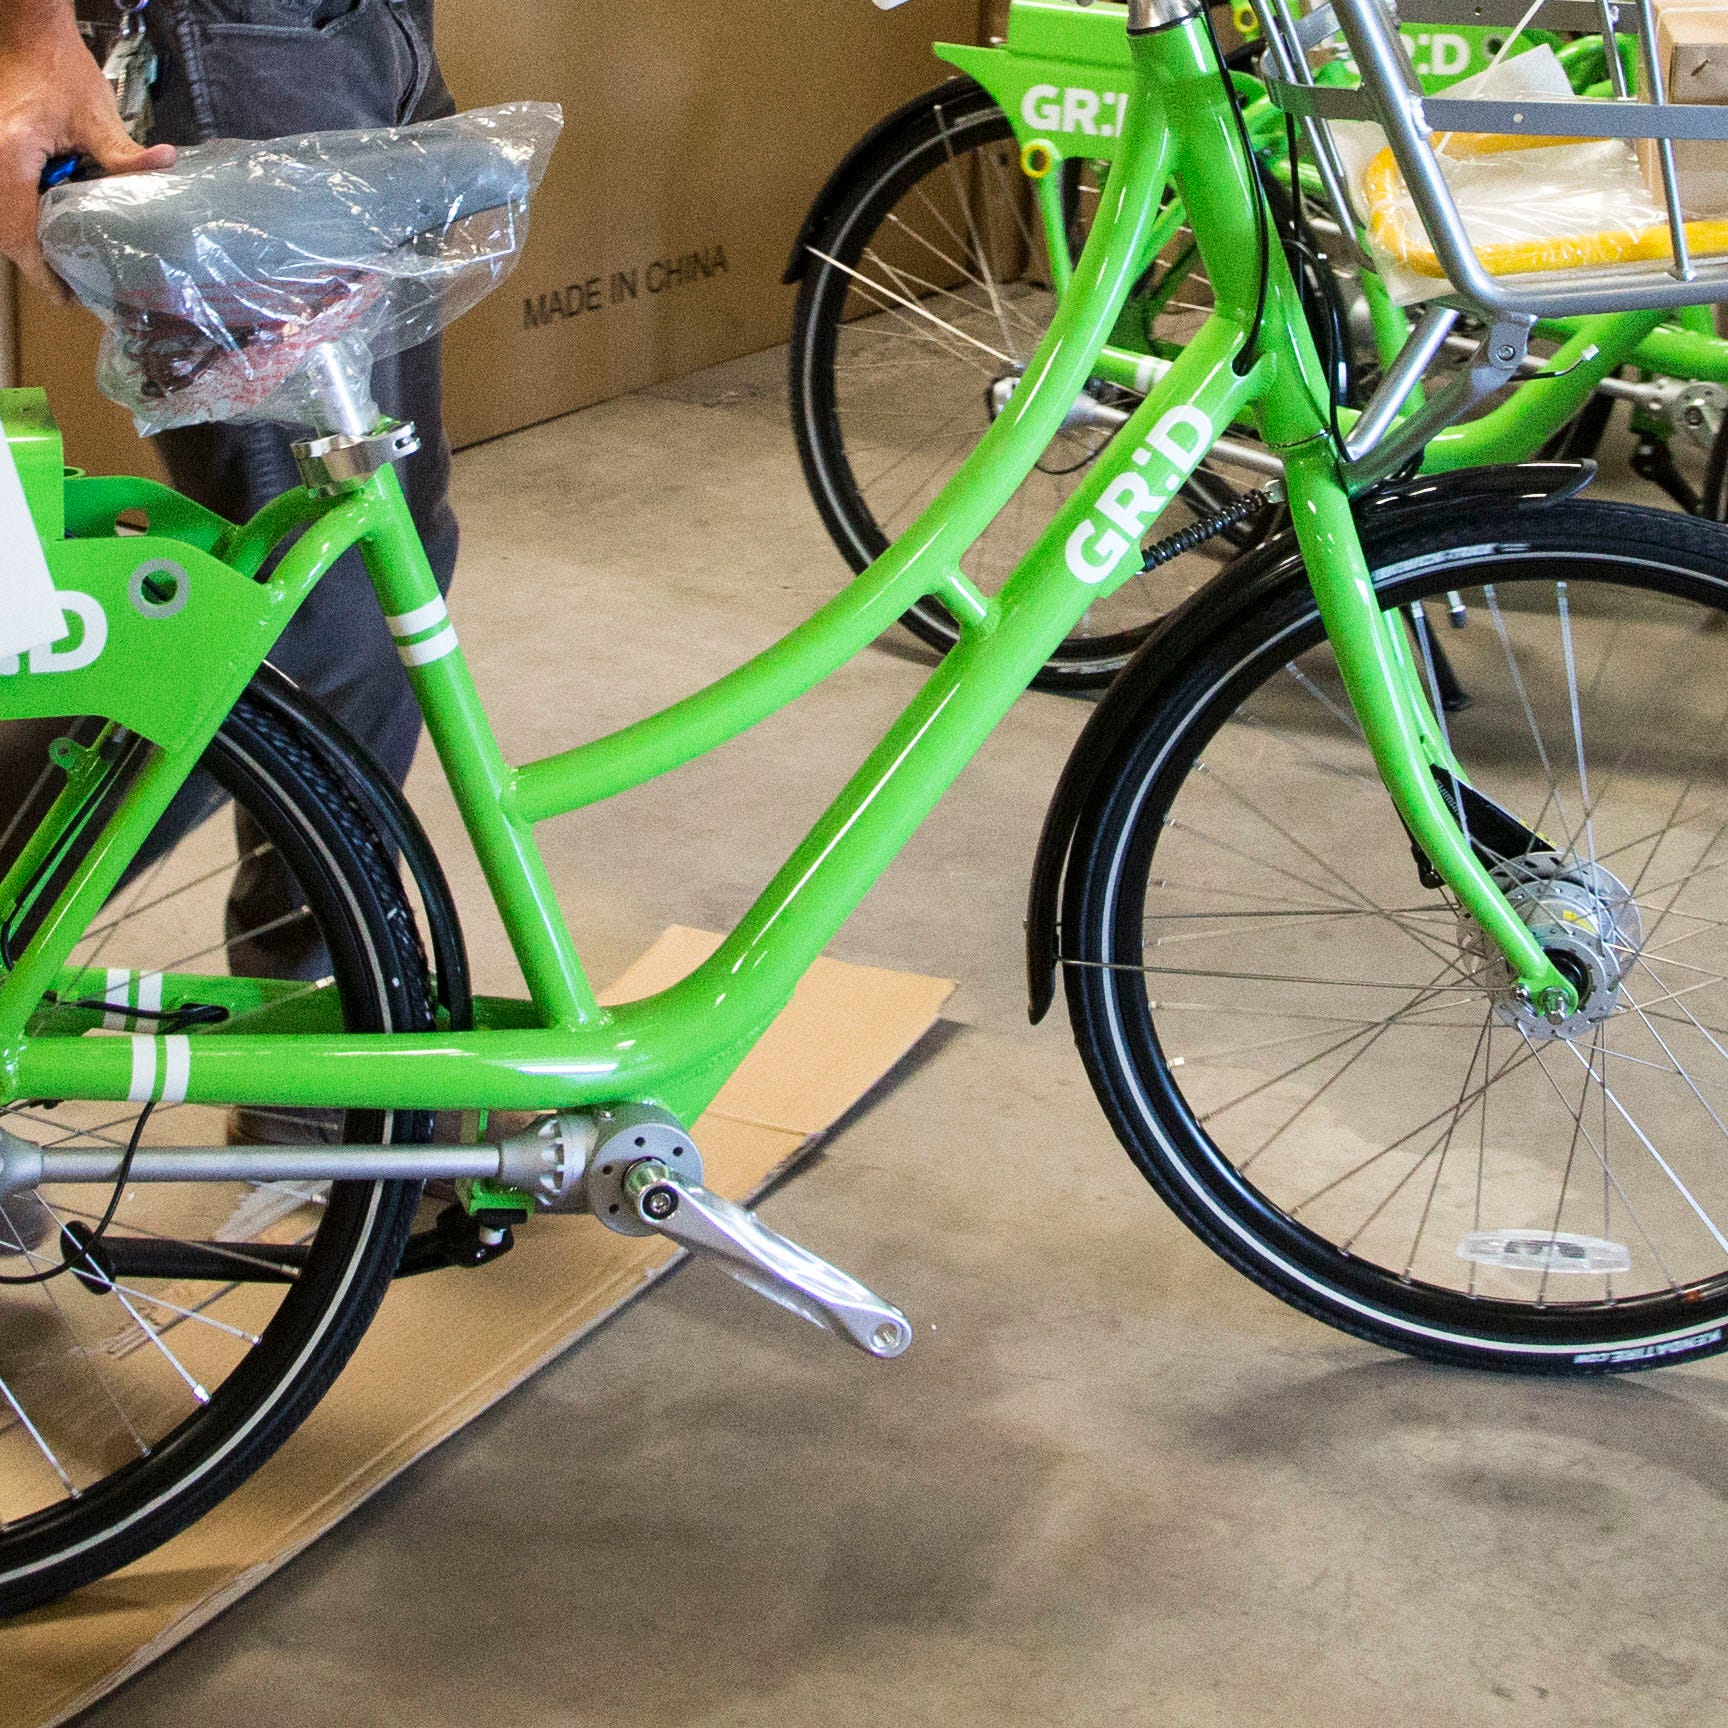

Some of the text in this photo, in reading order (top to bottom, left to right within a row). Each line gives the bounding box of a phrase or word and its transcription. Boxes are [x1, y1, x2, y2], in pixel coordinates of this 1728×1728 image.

[522, 244, 729, 329] MADE IN CHINA
